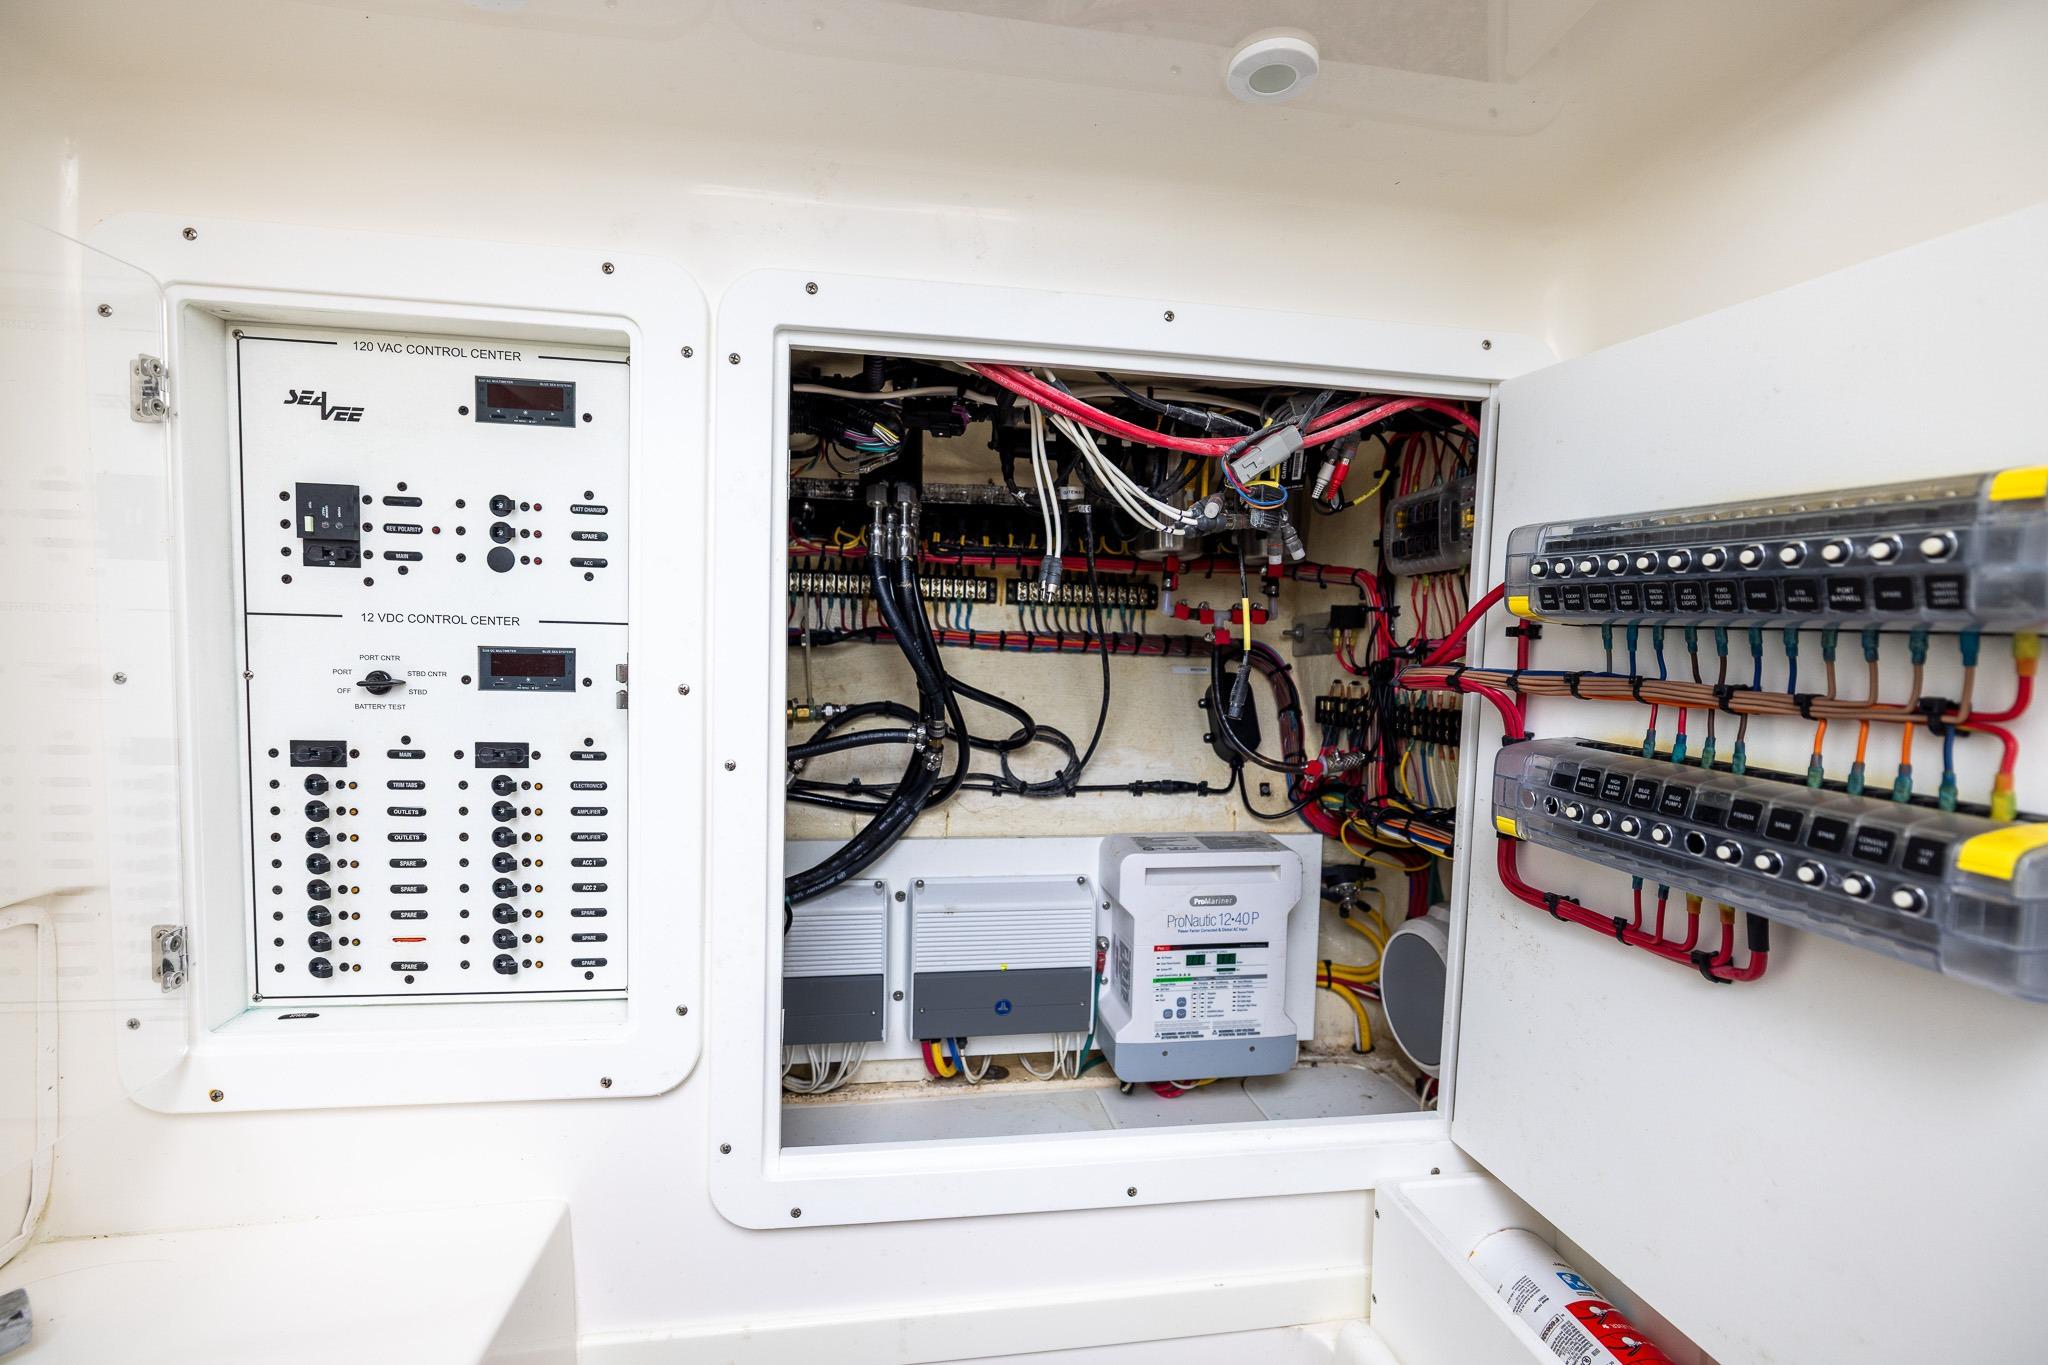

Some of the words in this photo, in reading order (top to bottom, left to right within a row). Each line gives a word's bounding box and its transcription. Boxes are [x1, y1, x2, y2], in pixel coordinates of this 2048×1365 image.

[353, 341, 374, 352] 120
[377, 342, 402, 354] VAC
[406, 344, 467, 358] CONTROL
[470, 348, 522, 362] CENTER
[361, 613, 374, 622] 12
[378, 613, 404, 623] VDC
[408, 614, 467, 624] CONTROL
[470, 616, 520, 626] CENTER
[1194, 897, 1232, 906] ProMariner
[1167, 913, 1217, 928] ProNautic
